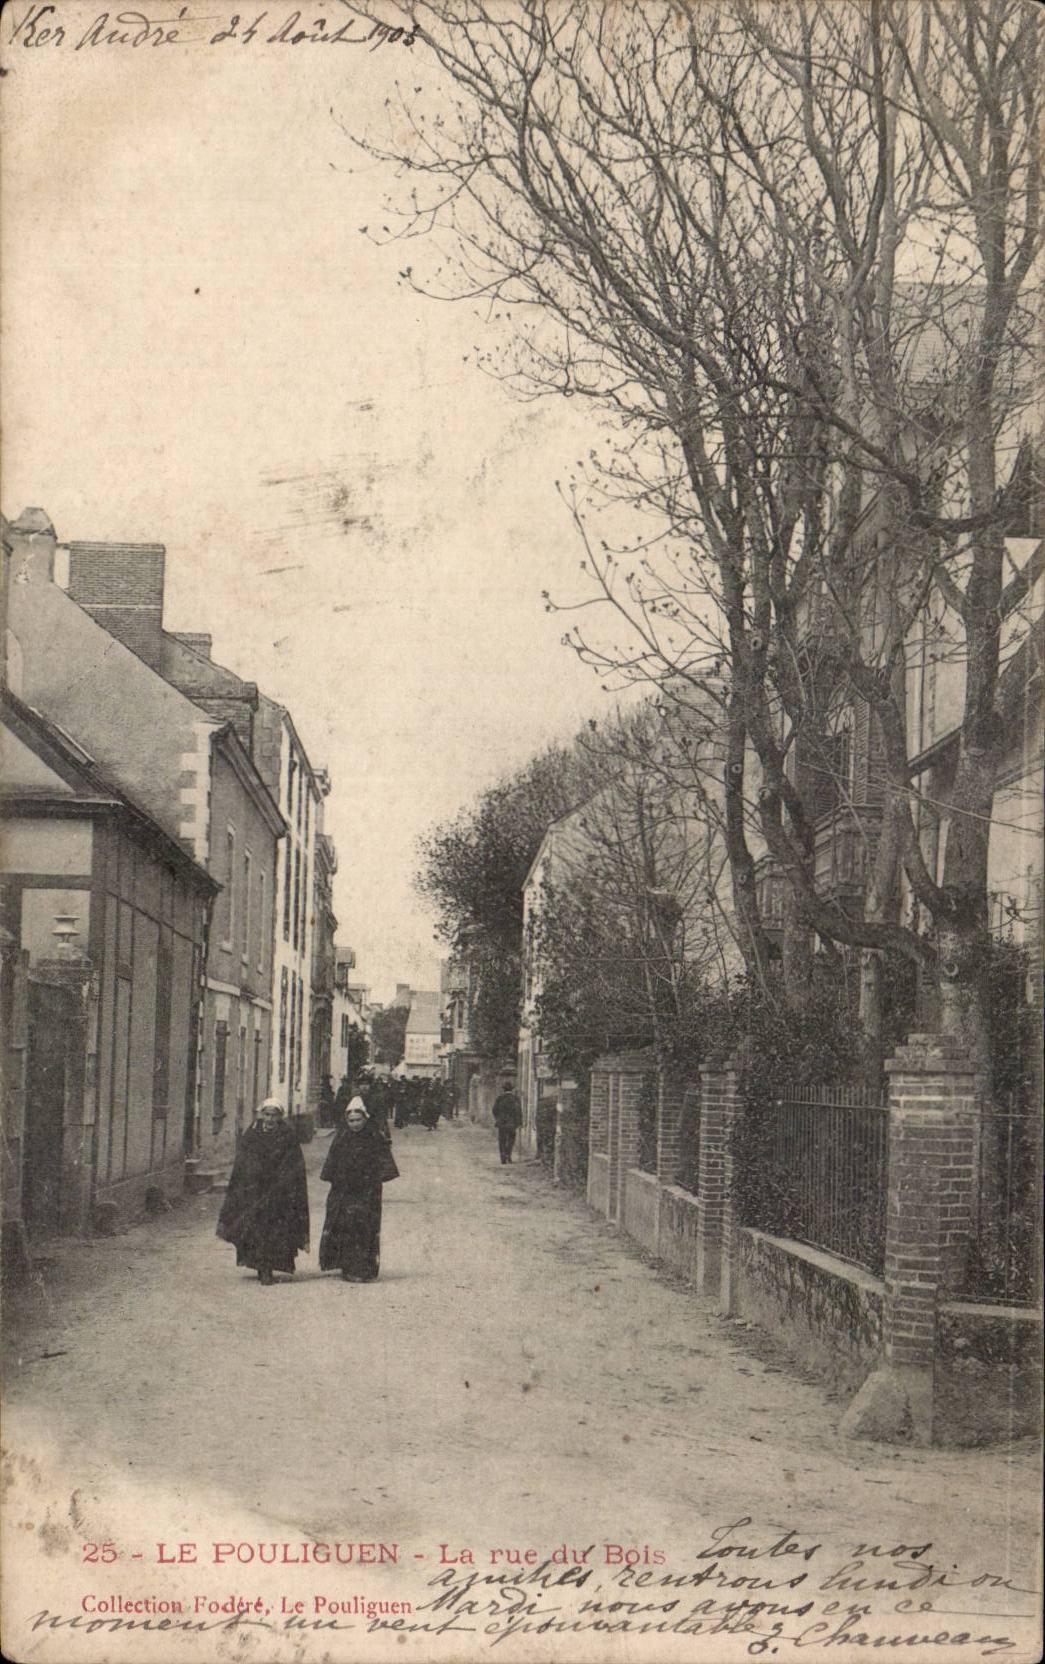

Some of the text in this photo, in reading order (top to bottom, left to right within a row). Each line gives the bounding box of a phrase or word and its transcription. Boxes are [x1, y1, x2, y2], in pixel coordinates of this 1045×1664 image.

[696, 1516, 933, 1561] Toutes nos
[416, 1586, 562, 1616] Mardi
[578, 1599, 681, 1614] nous
[690, 1598, 815, 1618] avons
[822, 1599, 872, 1615] en
[25, 1609, 272, 1632] moment
[284, 1614, 356, 1630] un
[366, 1615, 476, 1635] vent
